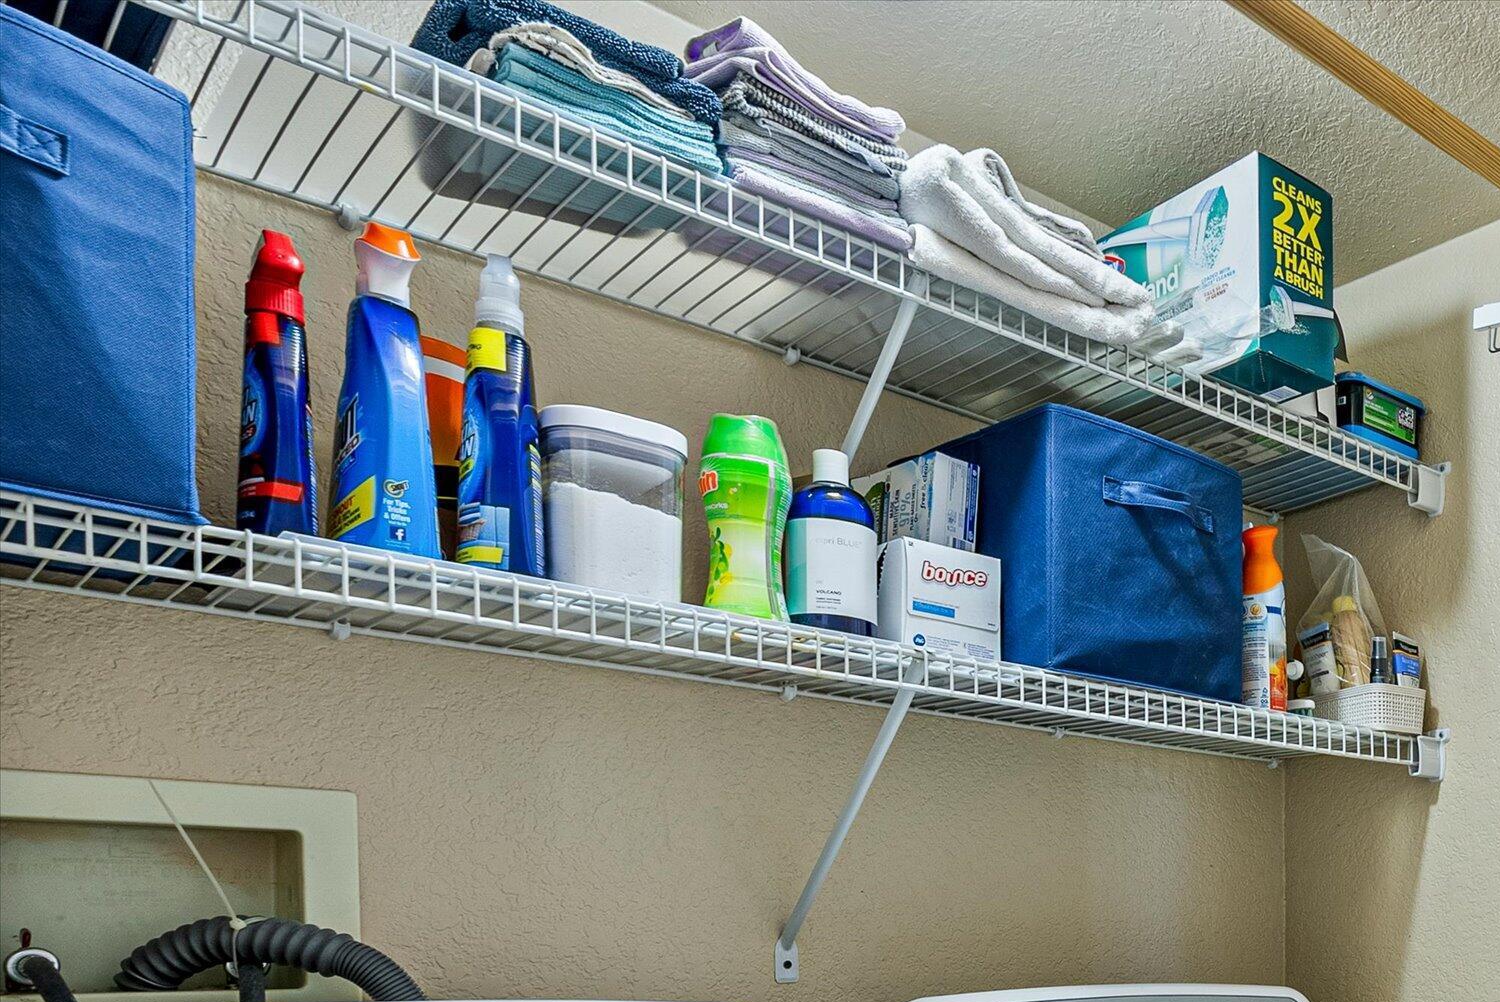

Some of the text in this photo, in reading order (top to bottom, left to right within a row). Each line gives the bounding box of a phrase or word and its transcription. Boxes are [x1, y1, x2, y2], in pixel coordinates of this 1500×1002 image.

[1272, 176, 1322, 214] CLEANS
[1273, 191, 1322, 252] 2X
[1273, 228, 1323, 267] BETTER
[1273, 245, 1323, 286] THAN
[1274, 265, 1323, 300] A BRUSH
[922, 560, 988, 587] bounce
